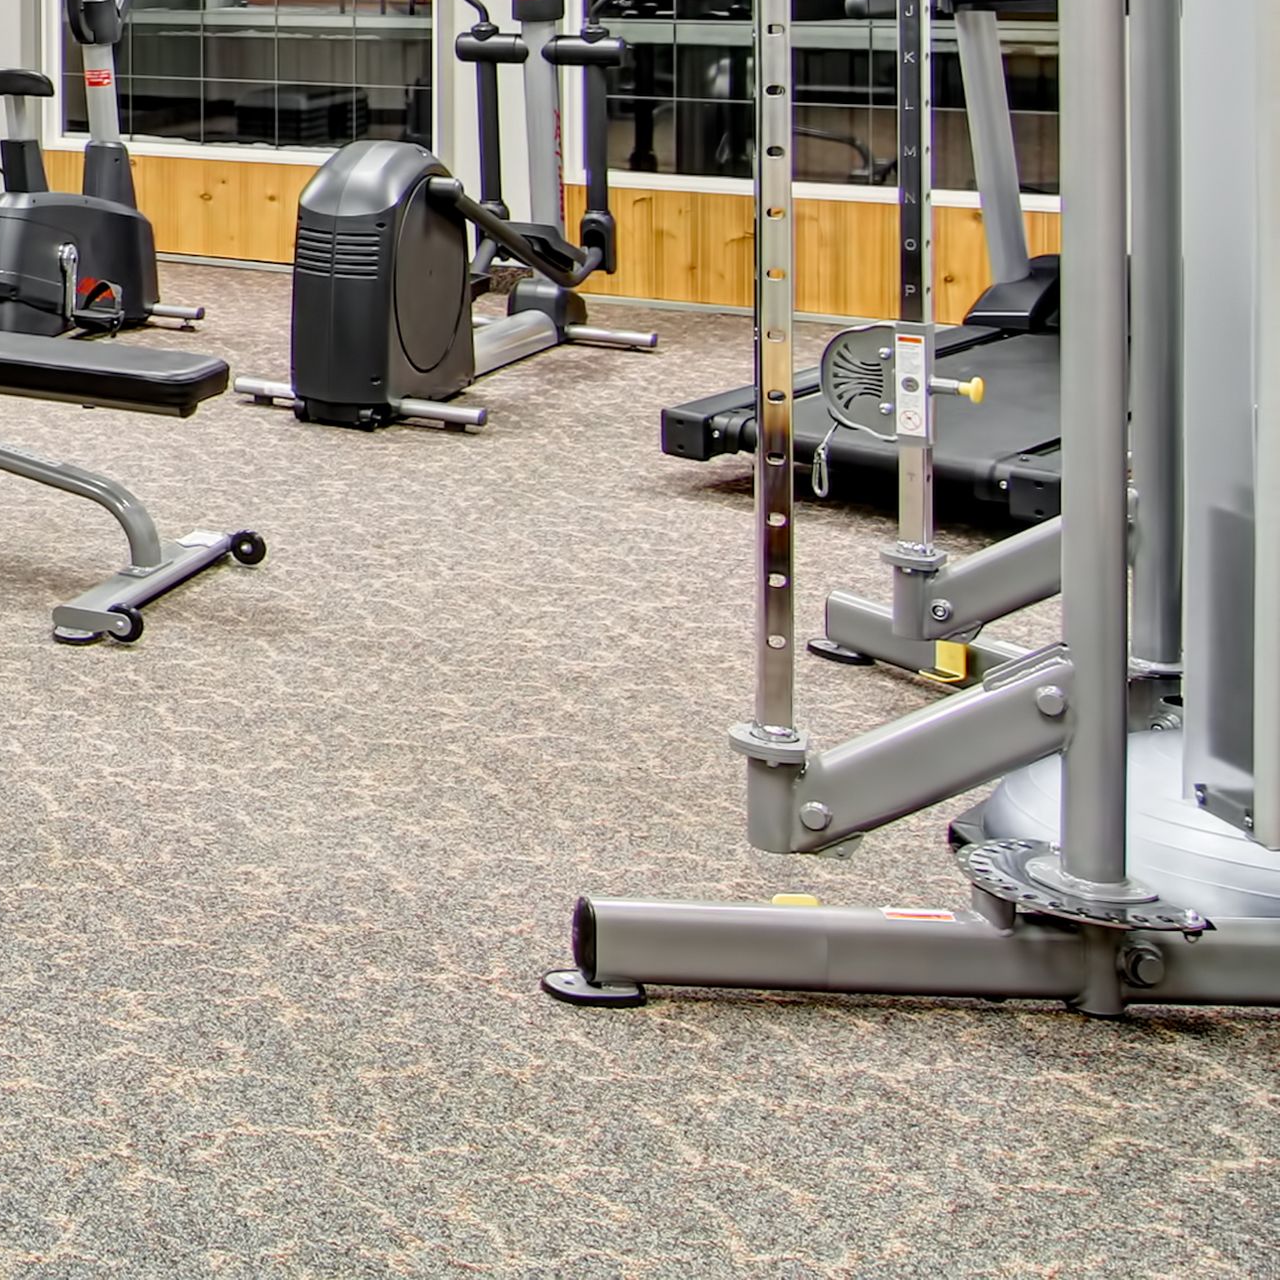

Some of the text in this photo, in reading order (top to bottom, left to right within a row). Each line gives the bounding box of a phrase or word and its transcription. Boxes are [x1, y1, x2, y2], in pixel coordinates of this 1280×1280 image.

[904, 4, 913, 17] J
[903, 51, 915, 63] K
[904, 97, 914, 110] L
[903, 145, 917, 157] M
[904, 192, 916, 204] N
[904, 238, 917, 251] O
[904, 284, 916, 297] P
